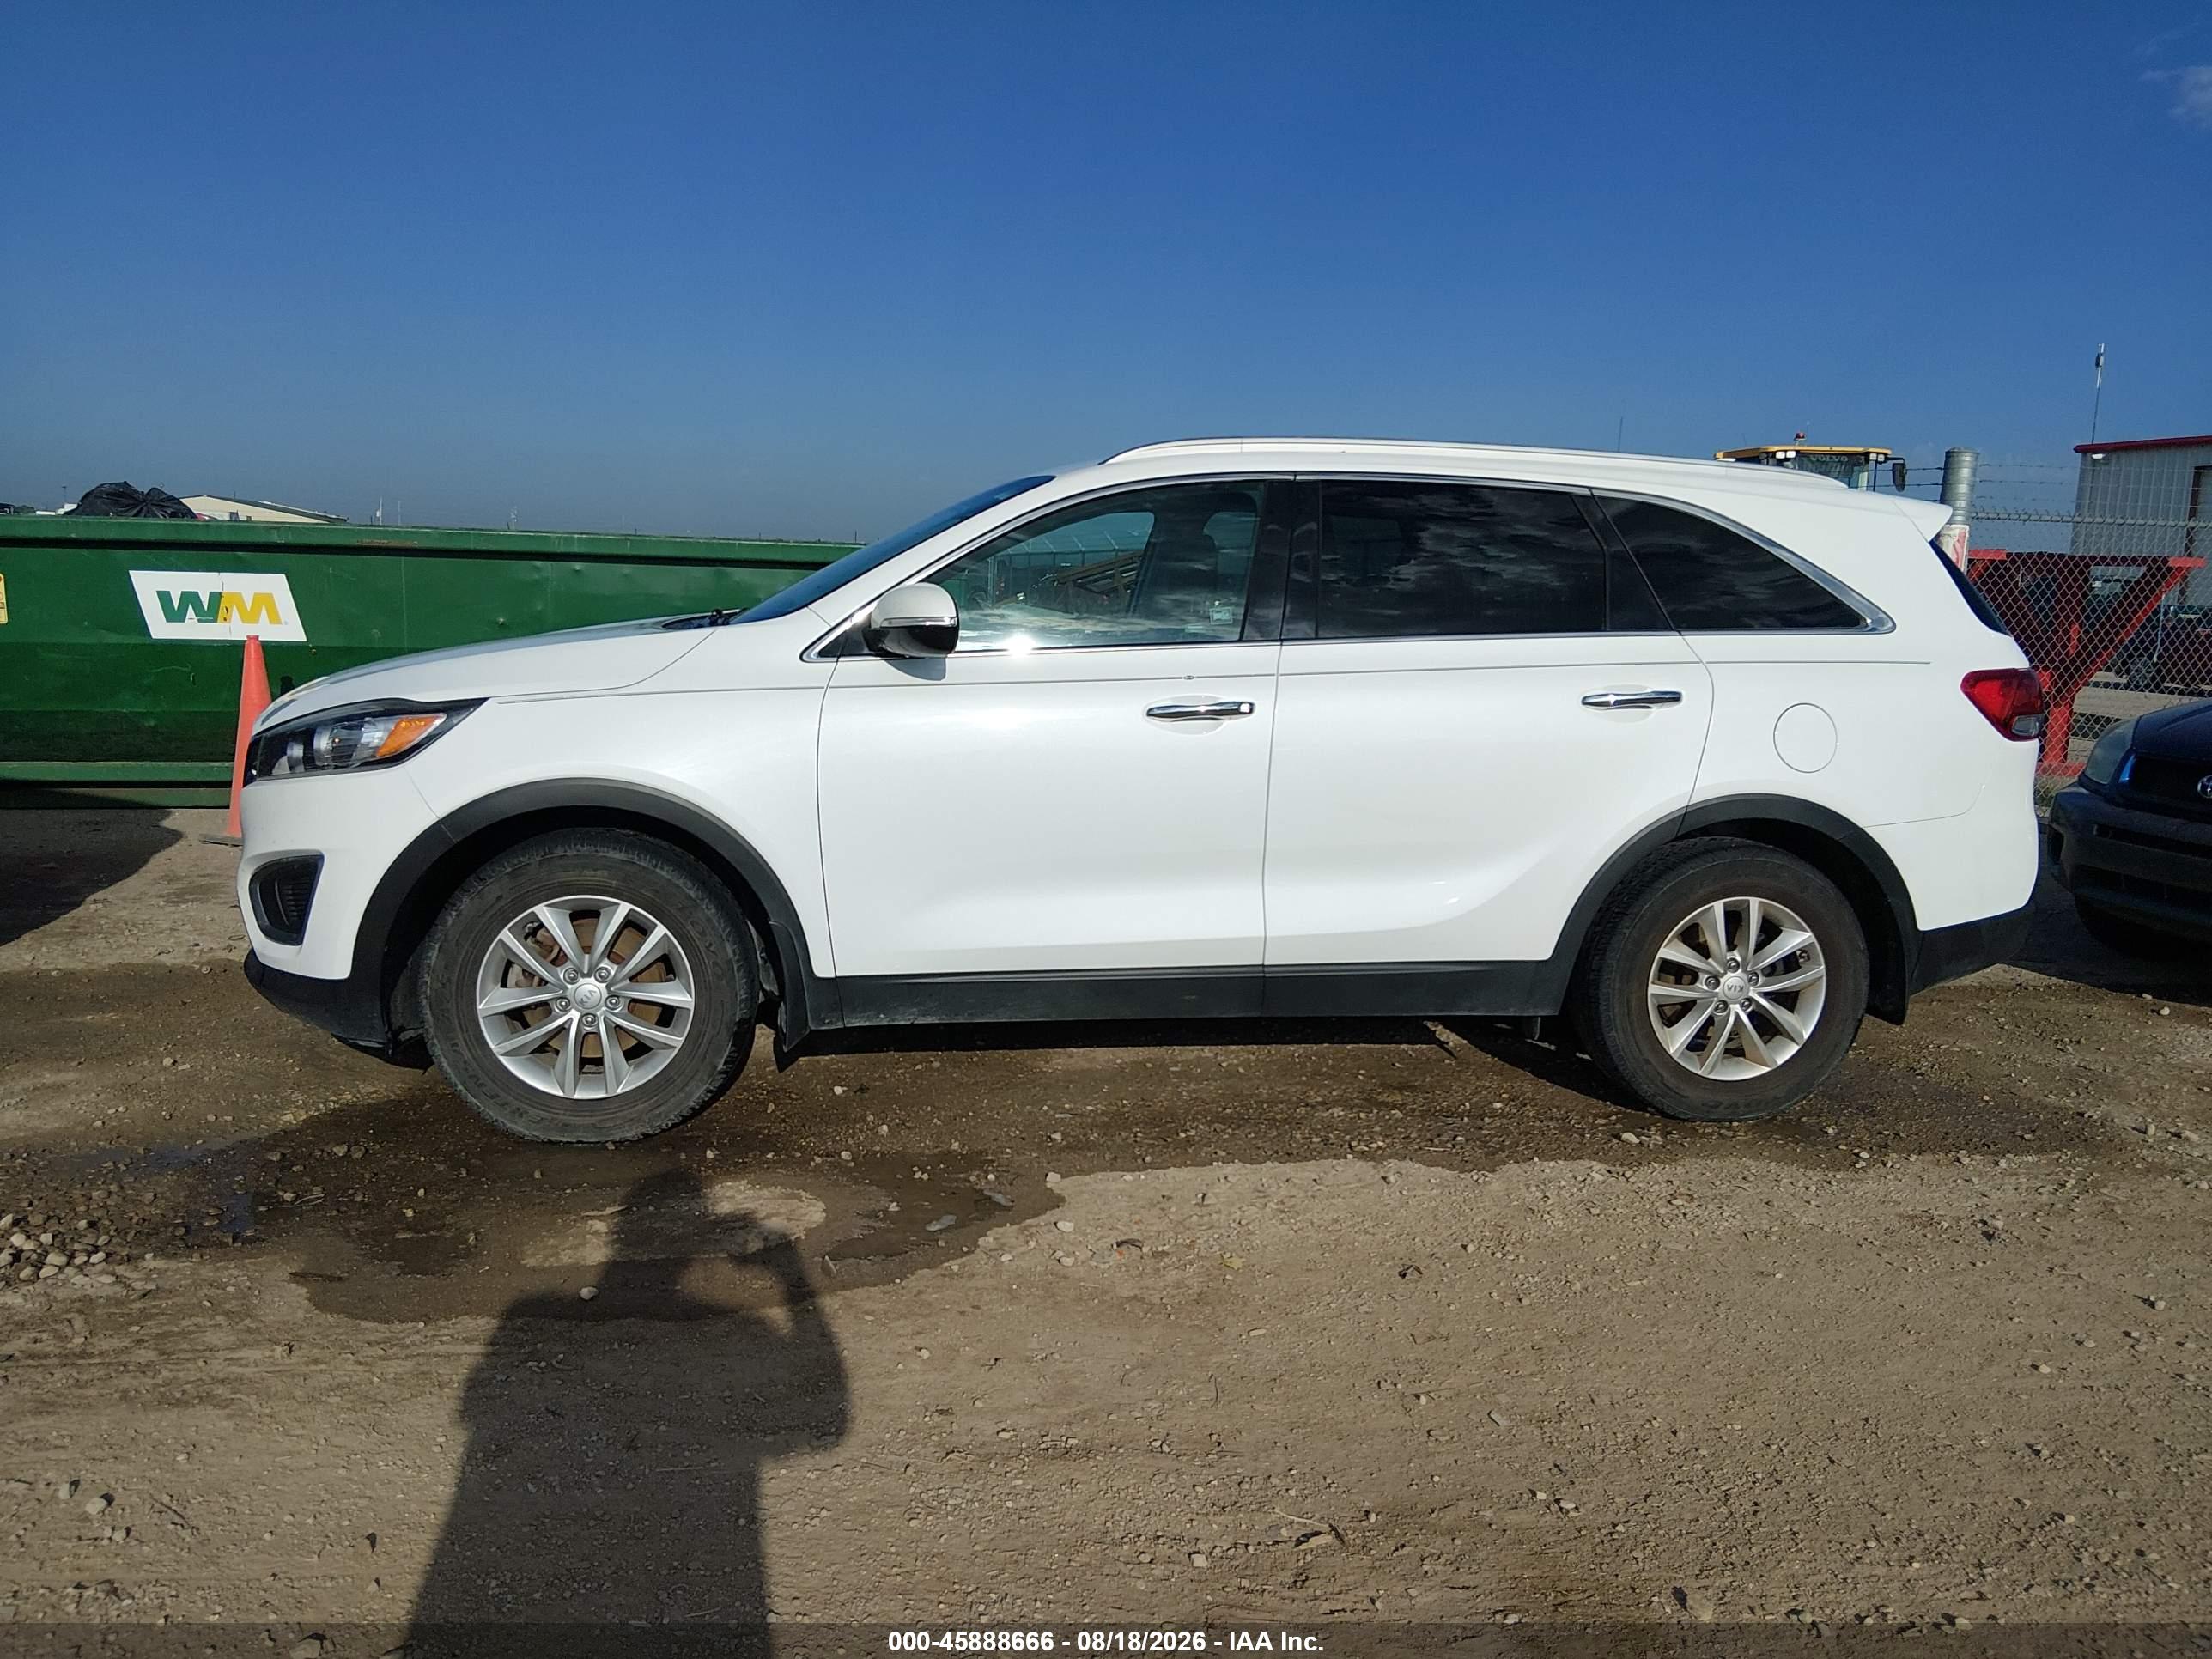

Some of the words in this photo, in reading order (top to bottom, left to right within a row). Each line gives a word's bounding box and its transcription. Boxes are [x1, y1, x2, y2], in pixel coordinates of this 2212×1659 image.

[155, 590, 283, 625] WM
[1726, 984, 1744, 993] KIA
[579, 989, 597, 1006] KIA
